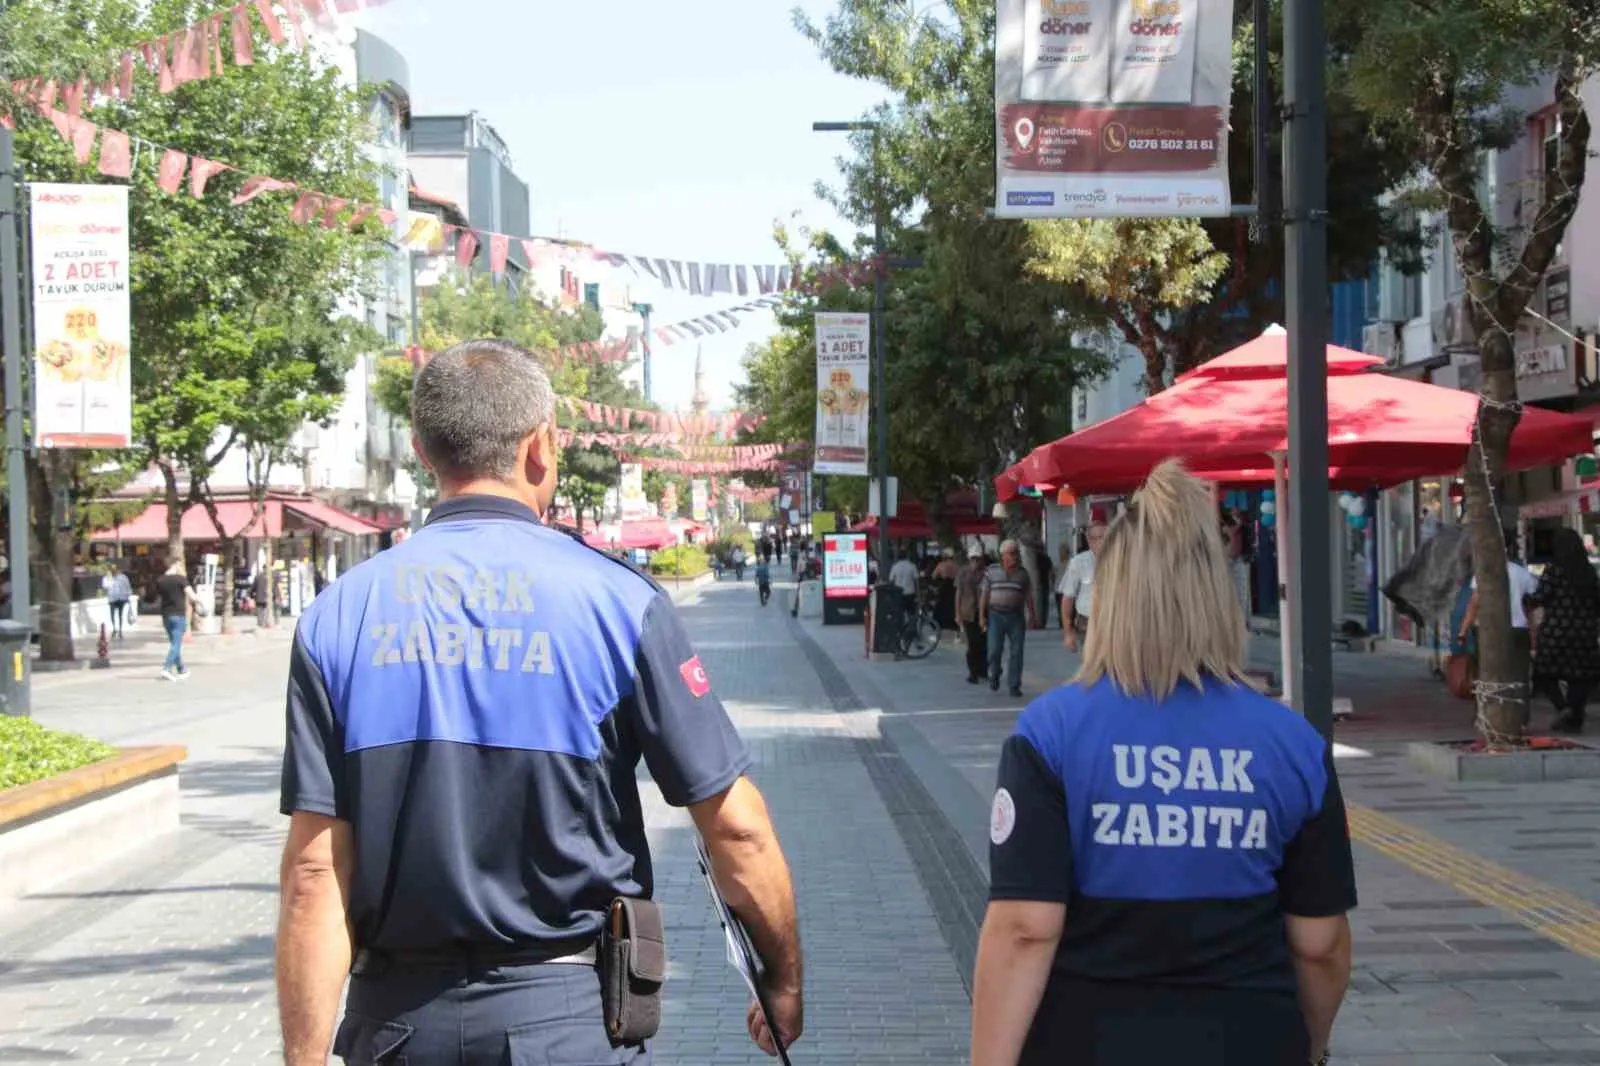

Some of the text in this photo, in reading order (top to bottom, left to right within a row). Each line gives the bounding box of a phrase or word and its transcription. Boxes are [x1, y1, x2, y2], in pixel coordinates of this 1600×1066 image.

[1039, 17, 1092, 35] döner
[1129, 18, 1182, 36] döner
[1160, 139, 1183, 150] 502
[44, 260, 120, 281] 2 ADET
[38, 284, 80, 296] TAVUK
[66, 312, 97, 329] 220
[832, 339, 865, 354] ADET
[370, 622, 556, 675] ZABITA
[1111, 743, 1255, 796] UŞAK
[1091, 802, 1268, 850] ZABITA
